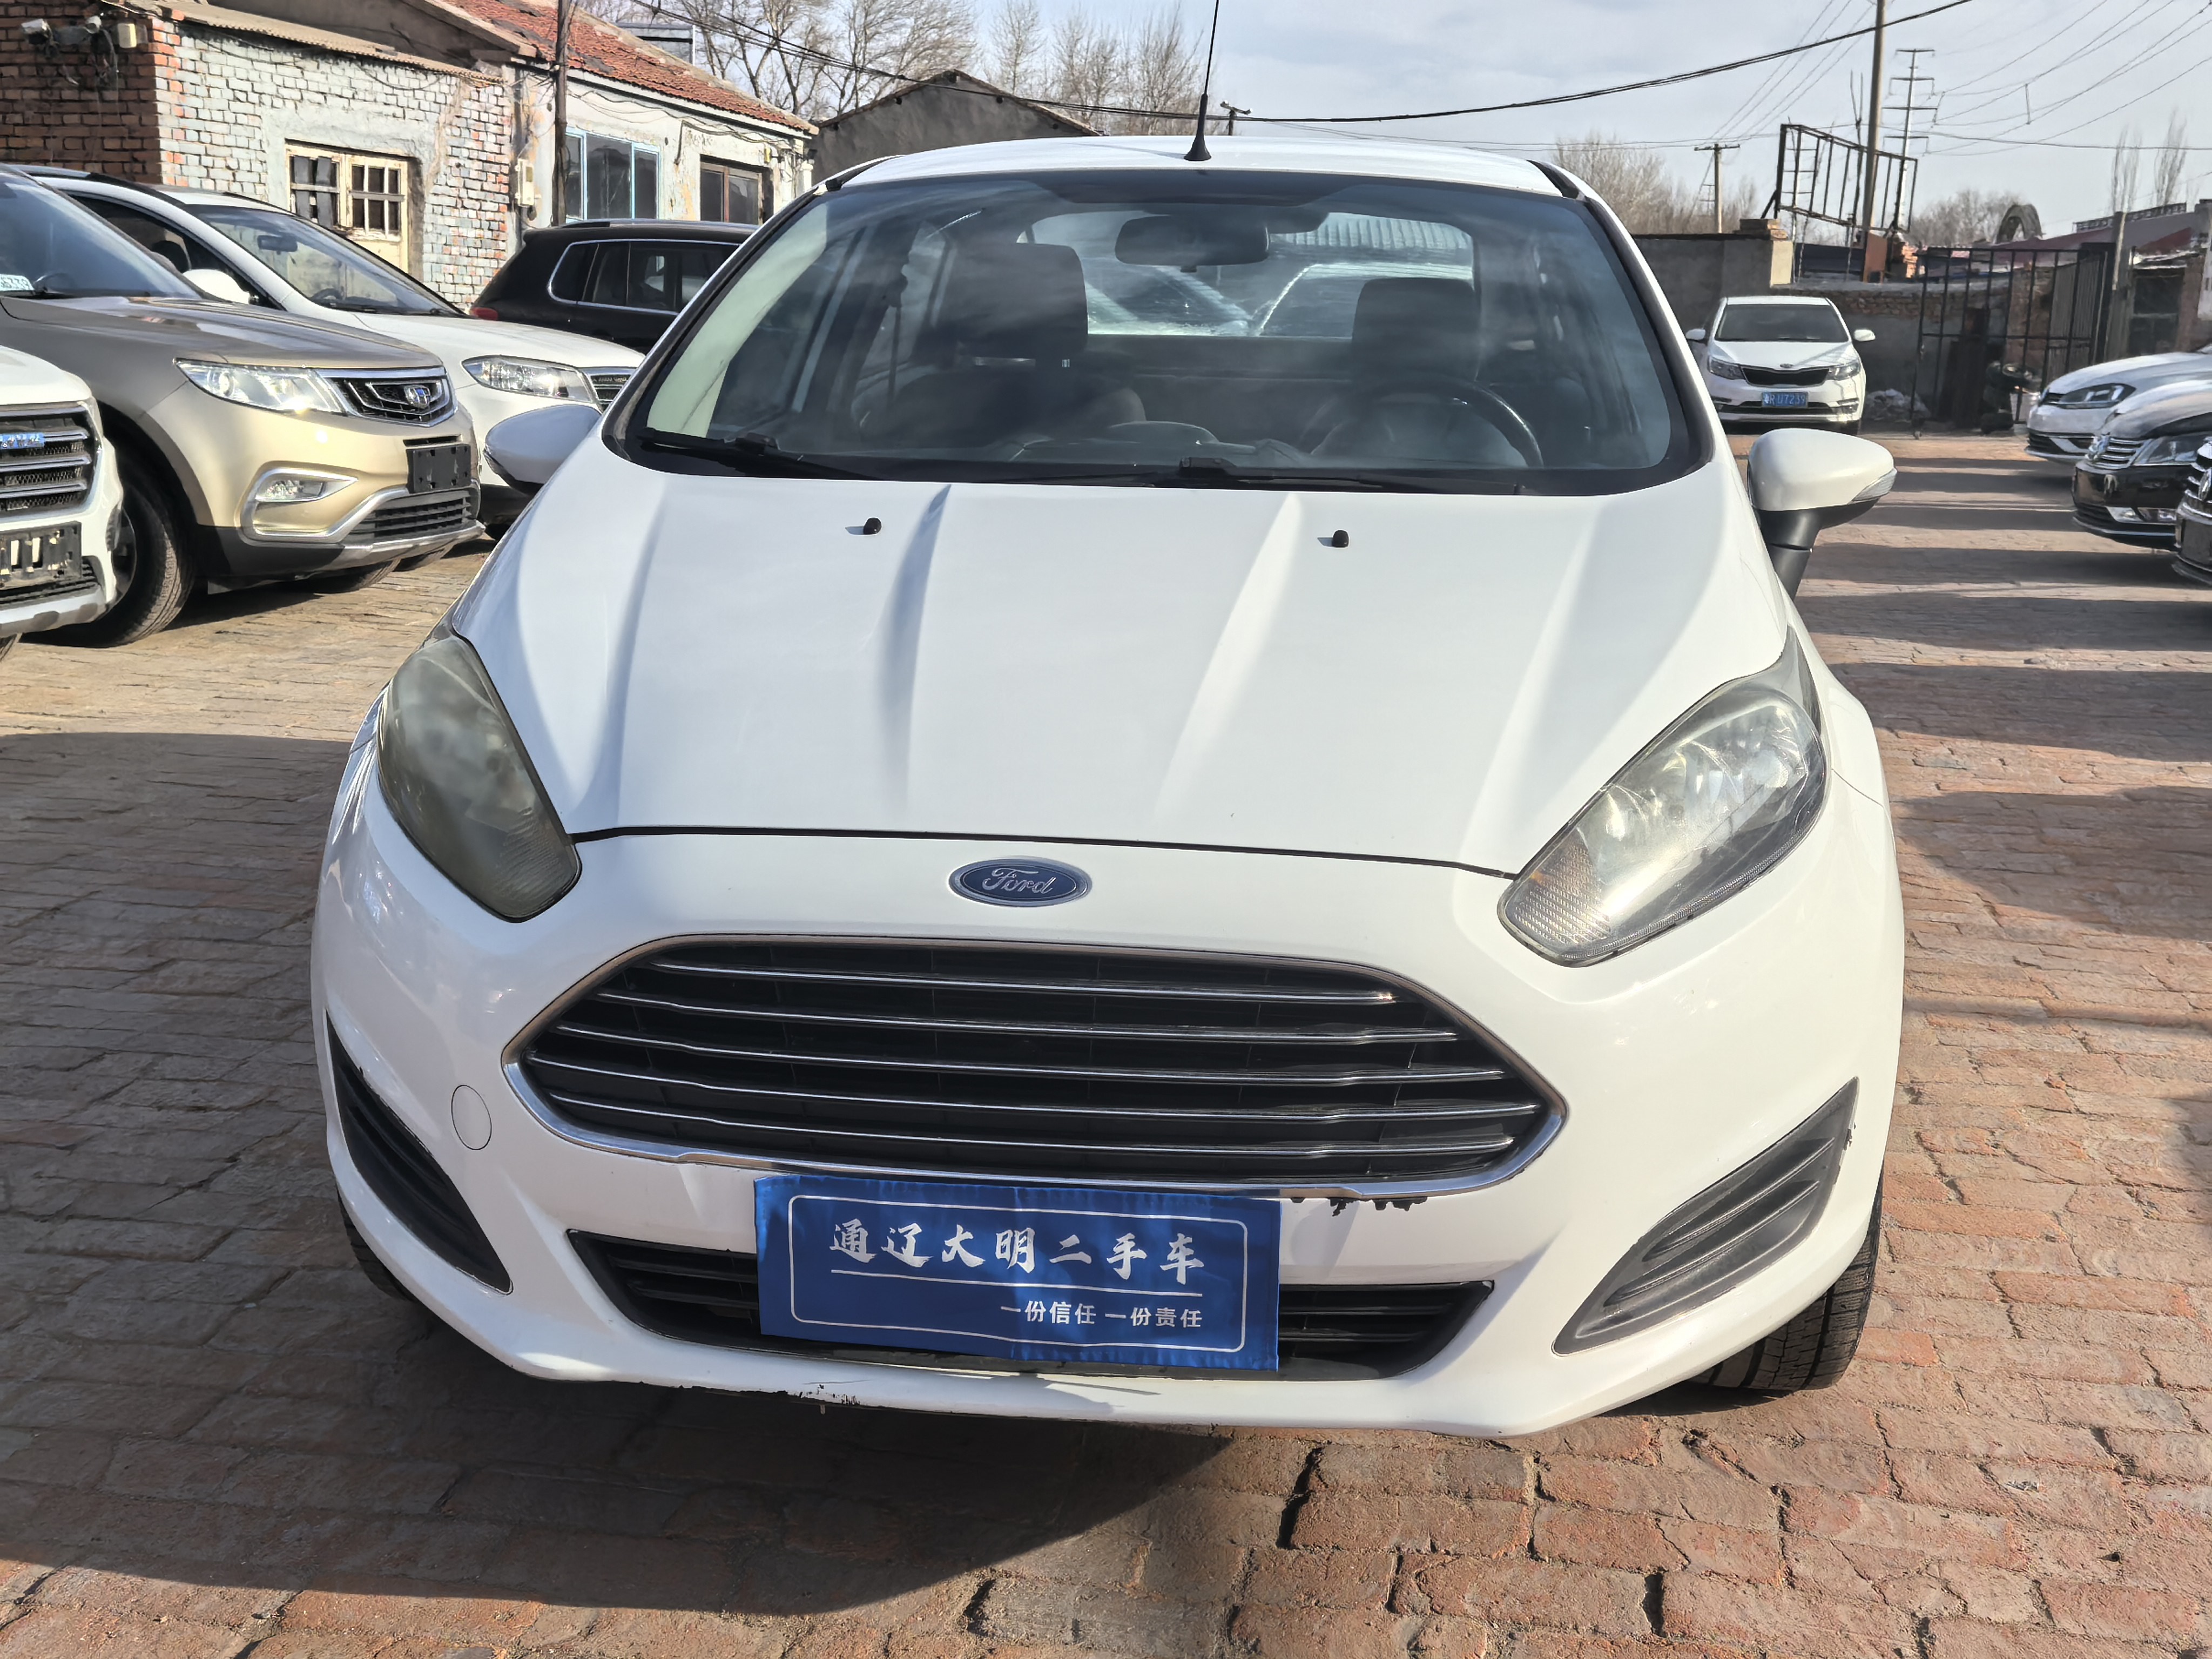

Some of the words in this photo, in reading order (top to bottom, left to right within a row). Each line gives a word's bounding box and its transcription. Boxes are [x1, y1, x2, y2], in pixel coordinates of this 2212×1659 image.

[982, 867, 1056, 894] Ford
[830, 1218, 1205, 1286] 通辽大明二手车
[1000, 1300, 1096, 1325] 一份信任
[1104, 1306, 1203, 1328] 一份责任
